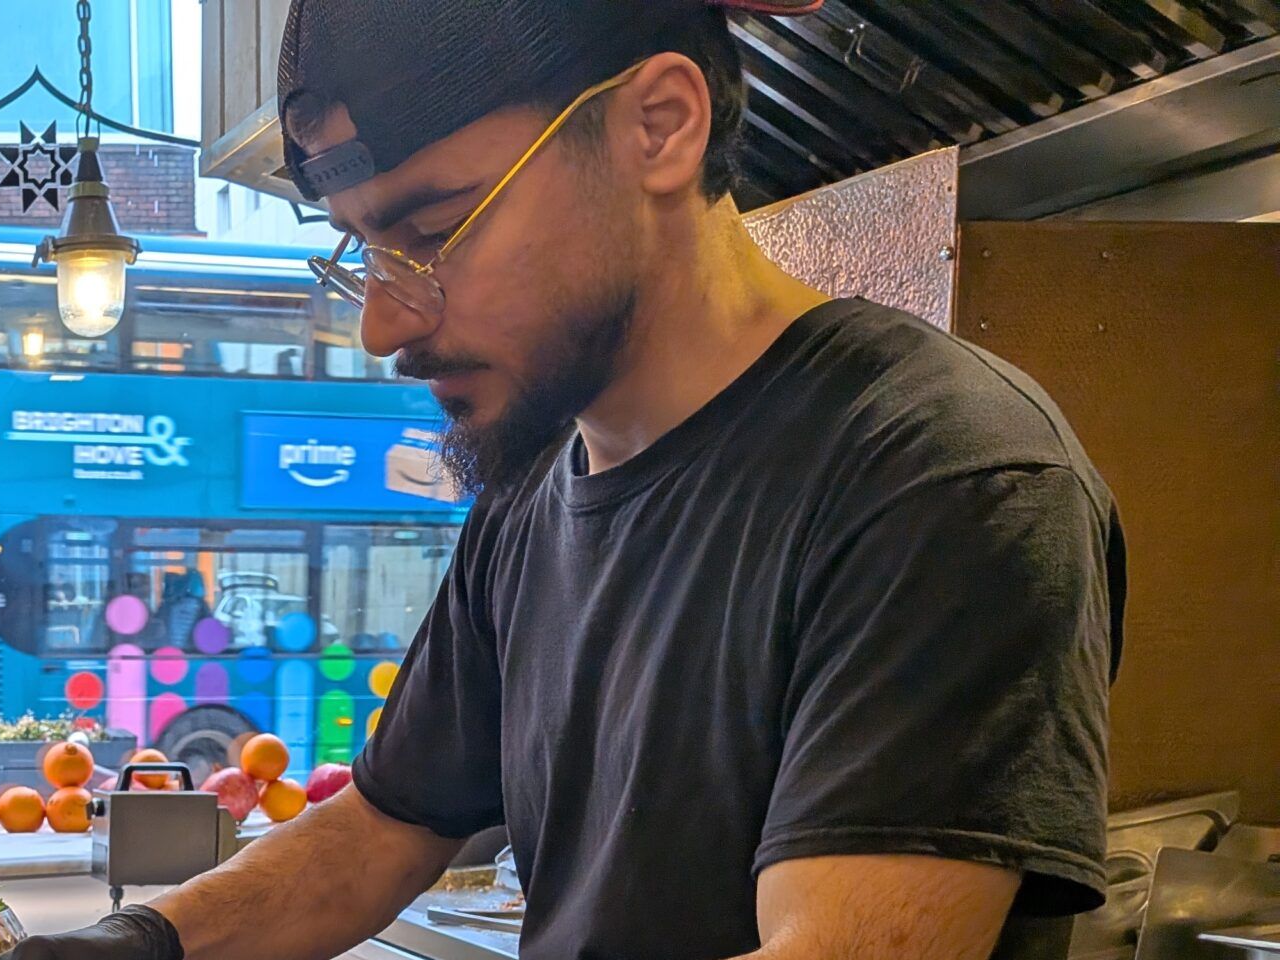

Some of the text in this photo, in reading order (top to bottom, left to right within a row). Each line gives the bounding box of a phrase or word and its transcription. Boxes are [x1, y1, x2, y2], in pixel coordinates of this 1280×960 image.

[11, 410, 144, 434] BRIGHTON
[72, 444, 145, 466] HOVE
[278, 438, 356, 469] prime
